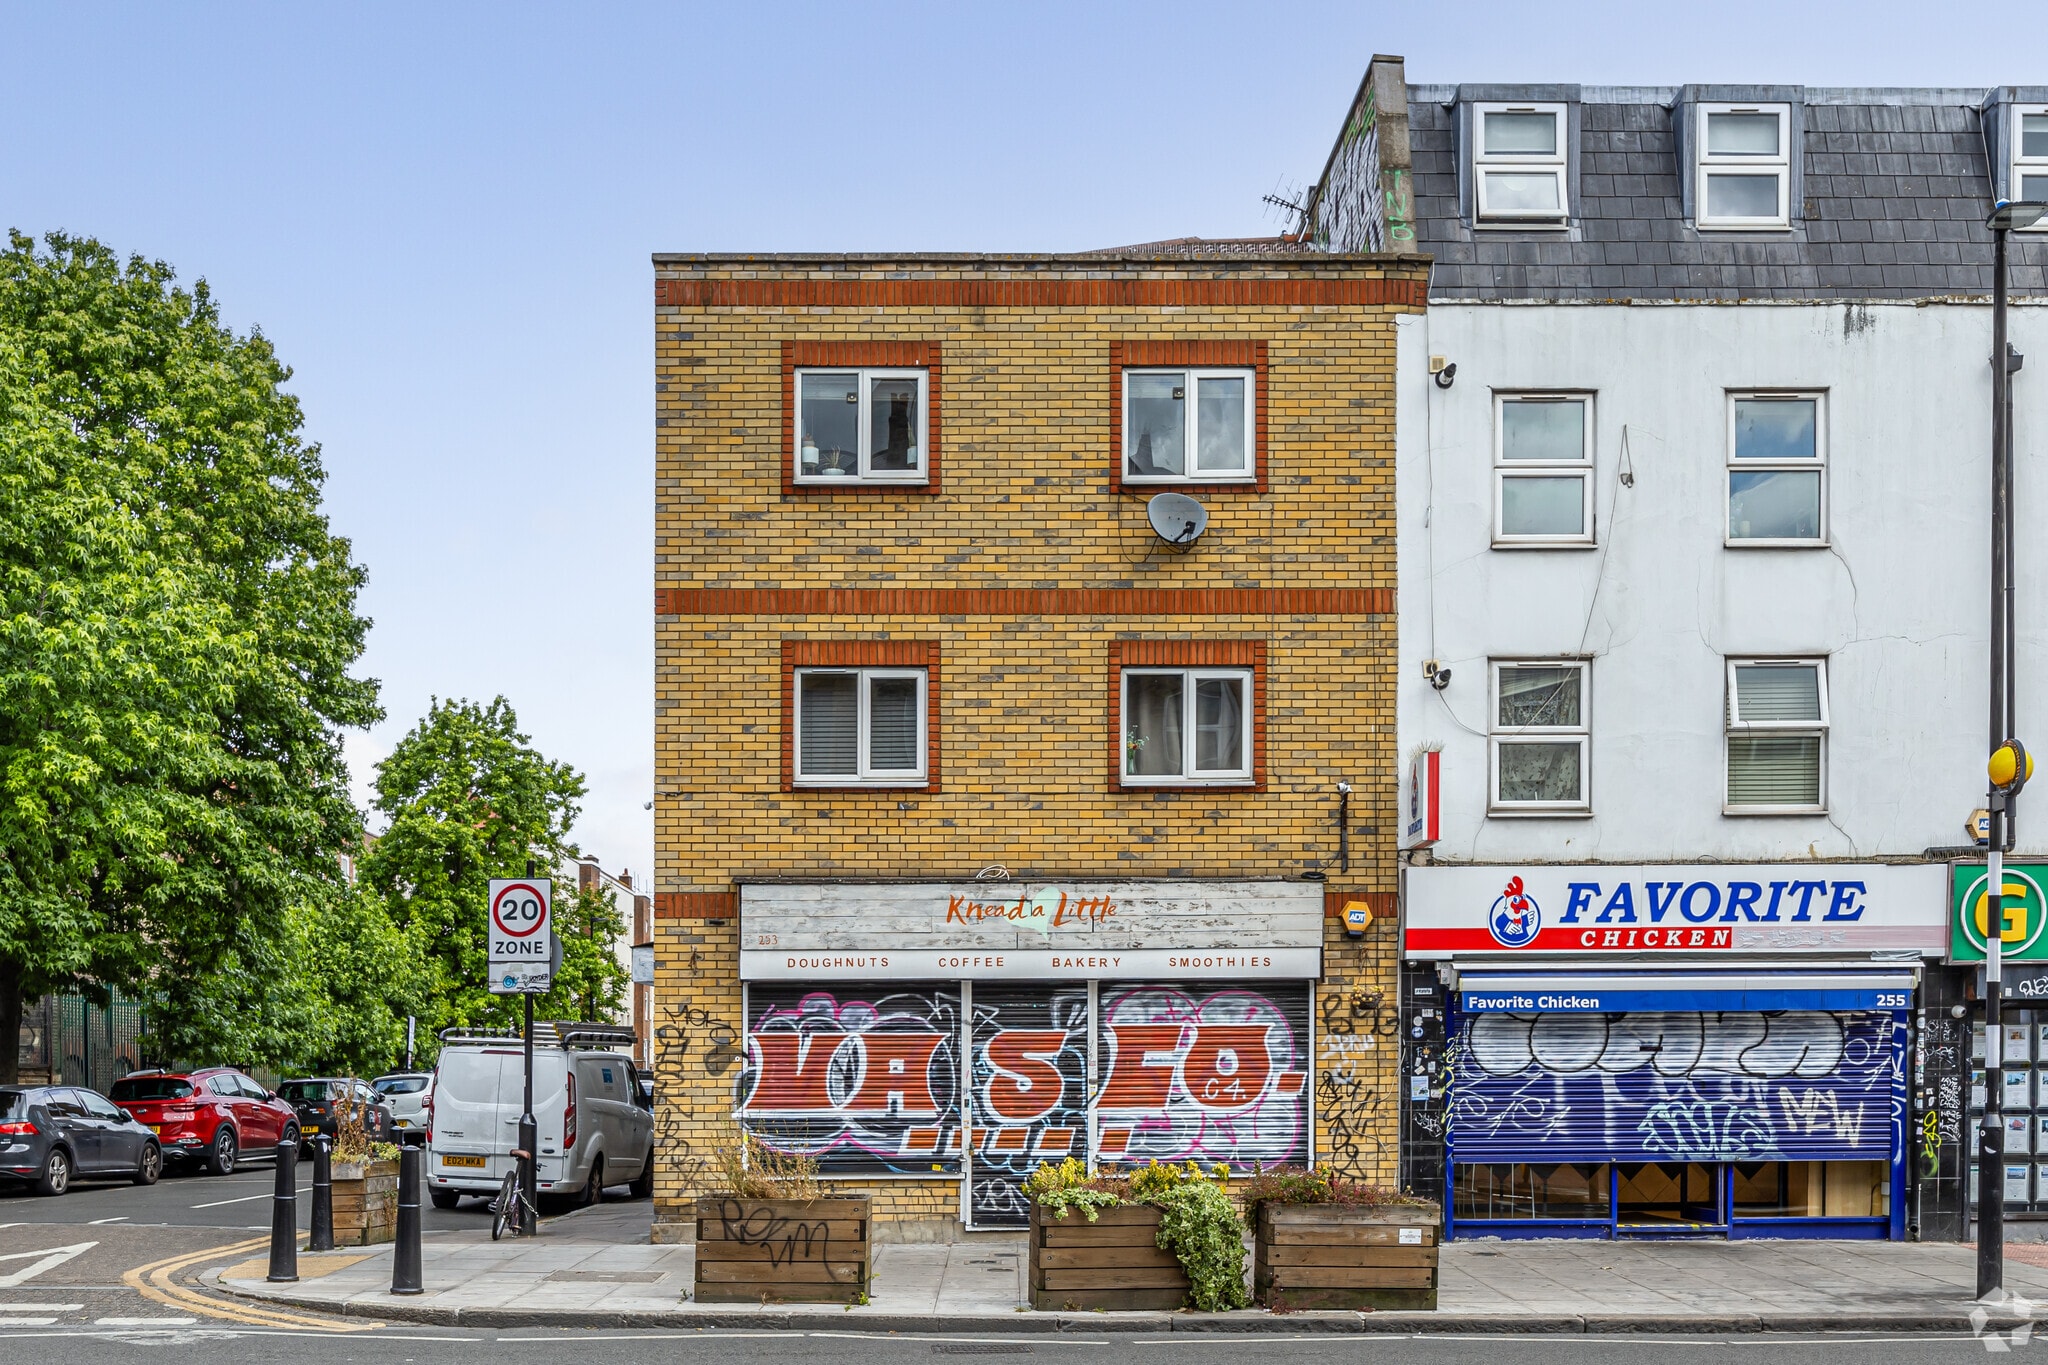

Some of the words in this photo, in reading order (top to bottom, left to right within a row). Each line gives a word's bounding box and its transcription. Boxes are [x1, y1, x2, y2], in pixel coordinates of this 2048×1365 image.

[1558, 880, 1868, 923] FAVORITE
[502, 899, 539, 921] 20
[946, 894, 1027, 925] Knead
[1031, 904, 1045, 917] a
[1053, 892, 1117, 927] Little
[1975, 884, 2027, 942] G
[1349, 912, 1365, 922] ADT
[758, 934, 778, 945] 253
[1580, 929, 1731, 947] CHICKEN
[495, 941, 544, 954] ZONE
[787, 957, 889, 968] DOUGHNUTS
[938, 957, 1005, 968] COFFEE
[1052, 957, 1121, 968] BAKERY
[1169, 957, 1271, 968] SMOOTHIES
[1468, 995, 1533, 1009] Favorite
[1537, 995, 1600, 1009] Chicken
[1876, 995, 1906, 1006] 255
